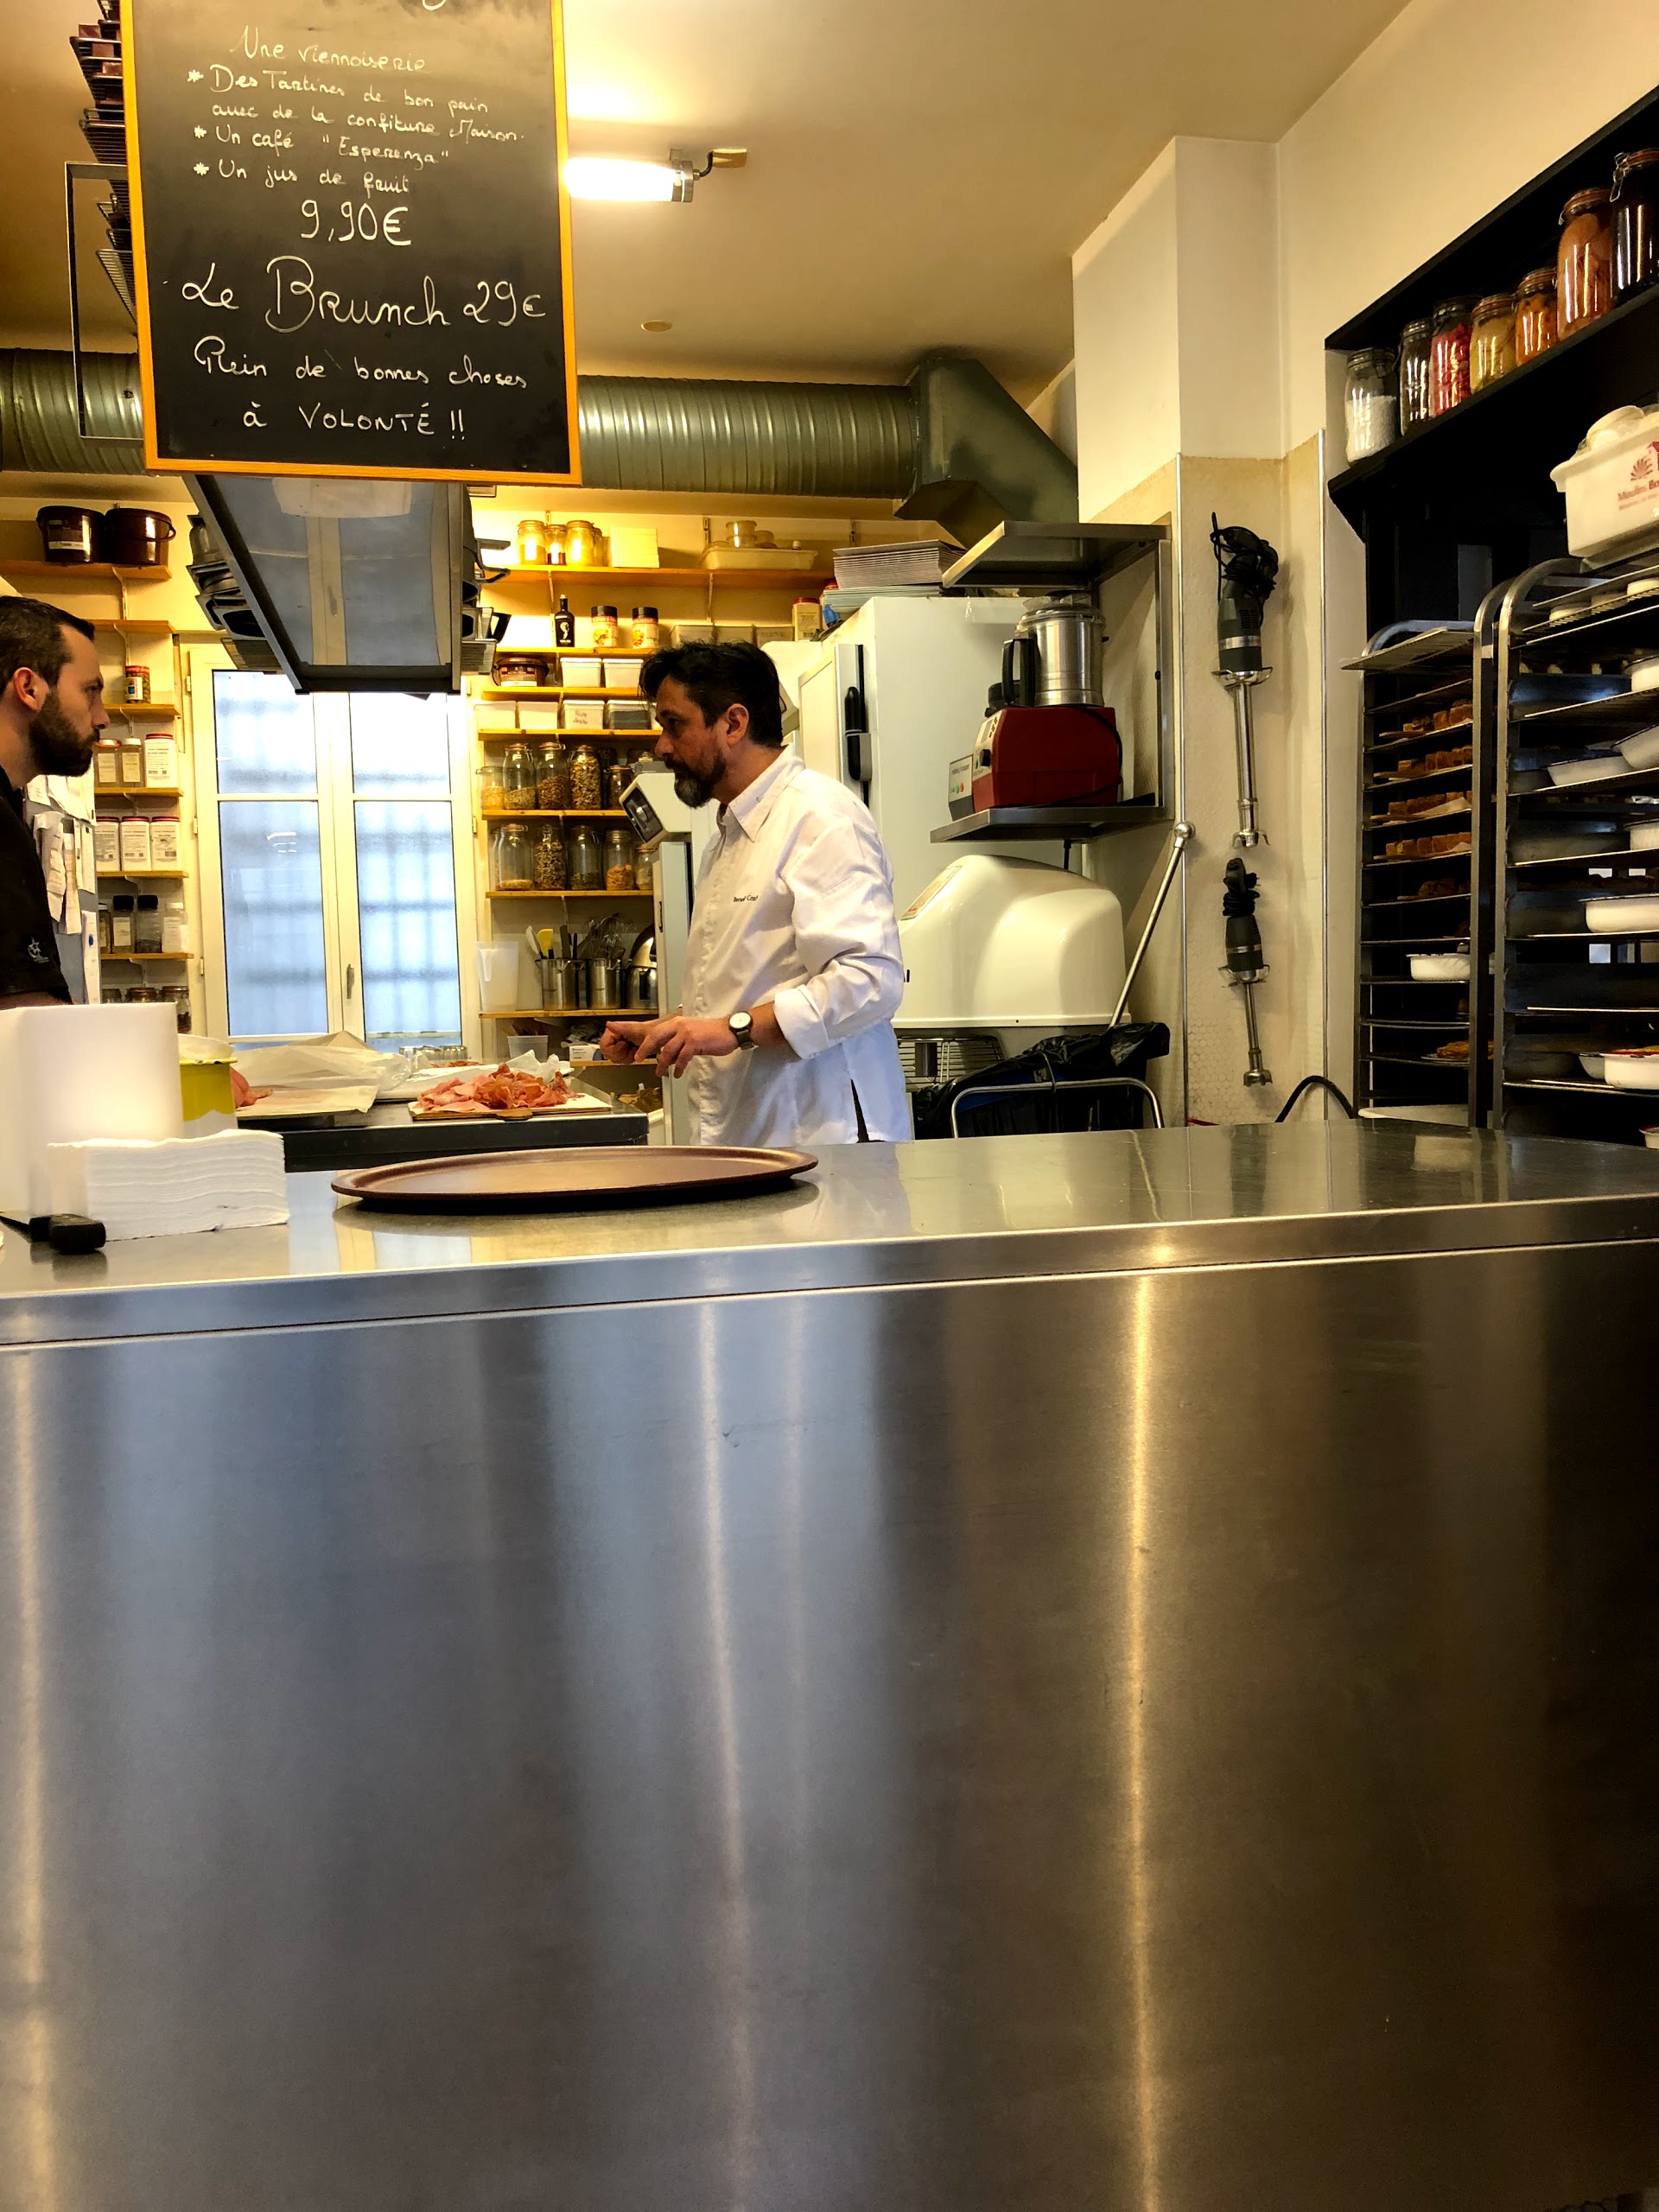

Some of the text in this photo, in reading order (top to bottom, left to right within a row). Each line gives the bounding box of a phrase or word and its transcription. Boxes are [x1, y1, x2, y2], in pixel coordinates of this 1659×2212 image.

[229, 25, 285, 59] Une
[210, 64, 488, 118] Des Tartines de bon pain
[272, 104, 297, 119] de
[311, 105, 334, 124] la
[347, 112, 438, 134] confiture
[216, 124, 241, 144] Un
[251, 129, 294, 156] café
[219, 159, 409, 199] Un jus de fruit
[301, 199, 411, 246] 9,90€
[181, 262, 239, 310] Le
[463, 281, 546, 327] 29€
[194, 334, 527, 389] Plein de bonnes choses
[243, 401, 267, 427] à
[298, 402, 435, 435] VOLONTÉ
